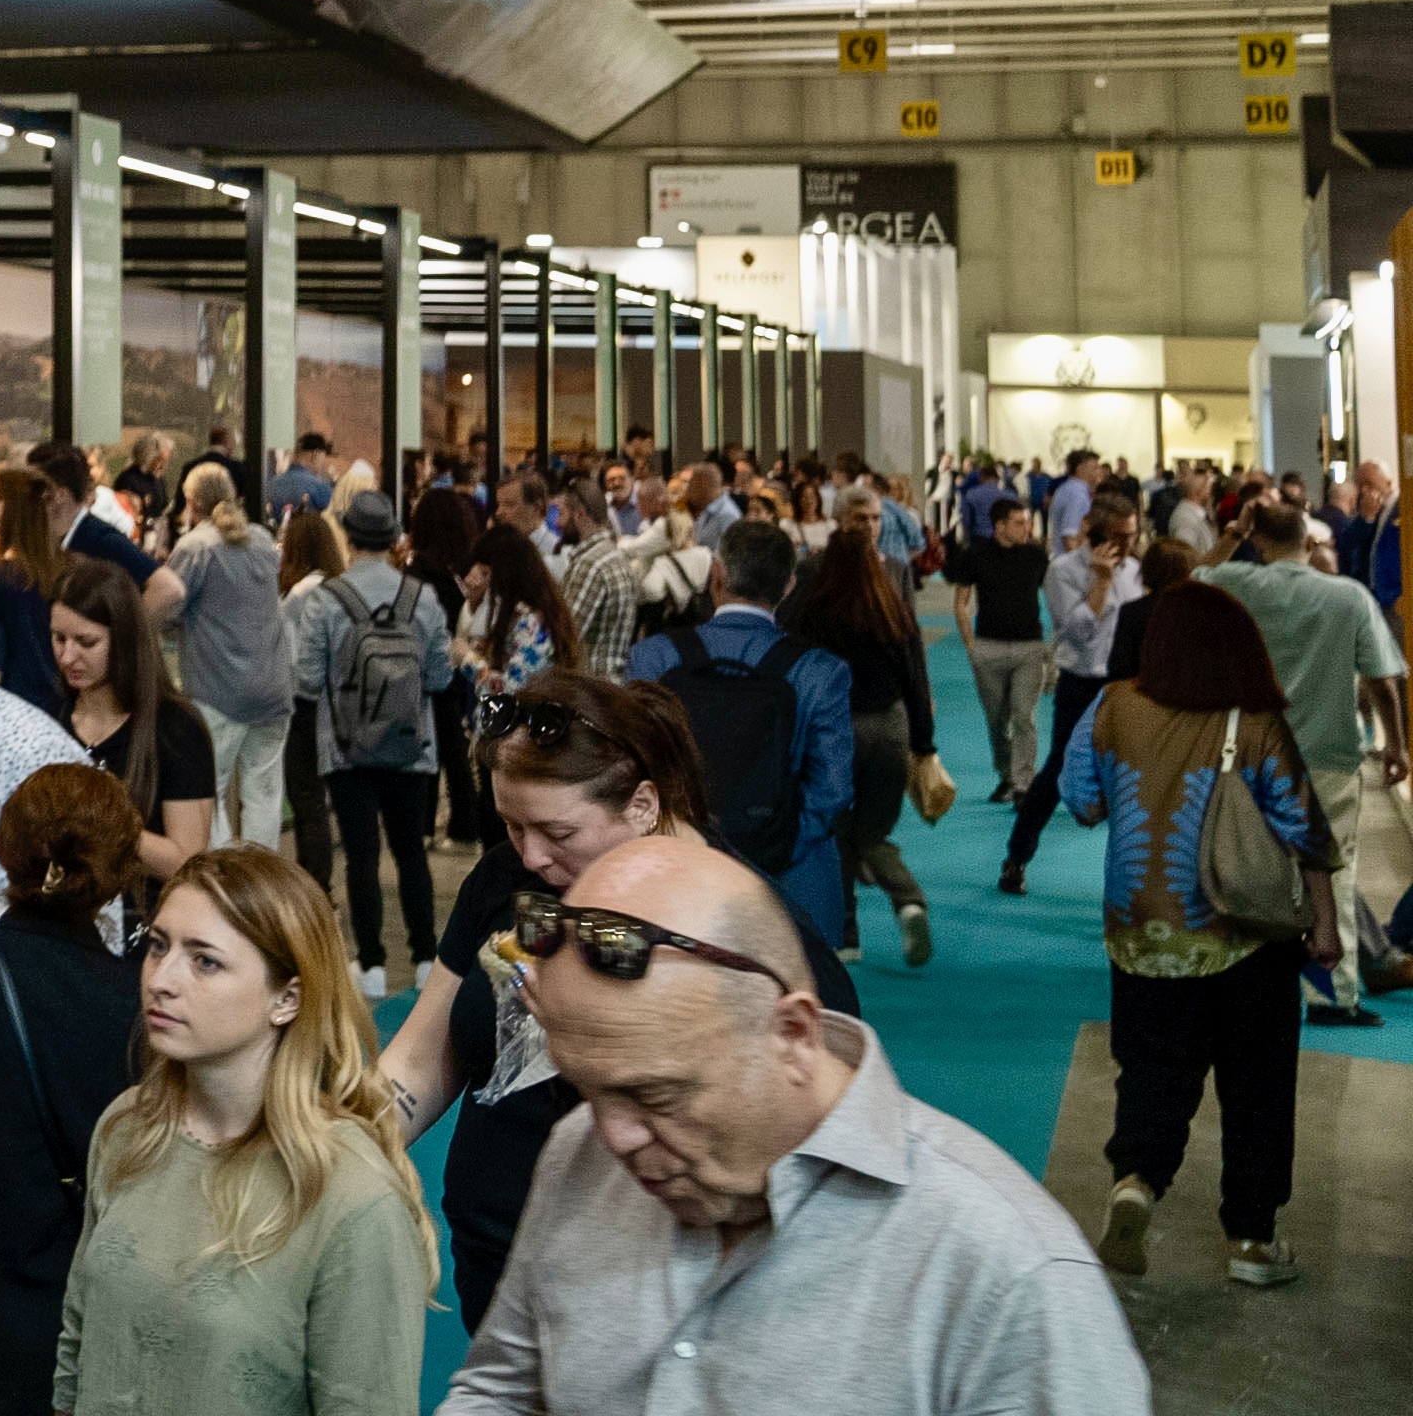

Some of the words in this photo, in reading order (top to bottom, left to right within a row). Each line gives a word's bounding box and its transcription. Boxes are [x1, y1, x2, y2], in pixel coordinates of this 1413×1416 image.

[846, 36, 879, 64] C9
[1246, 38, 1289, 70] D9
[901, 106, 938, 131] C10
[1246, 100, 1290, 125] D10
[1099, 159, 1131, 179] D11
[809, 210, 948, 248] RGEA
